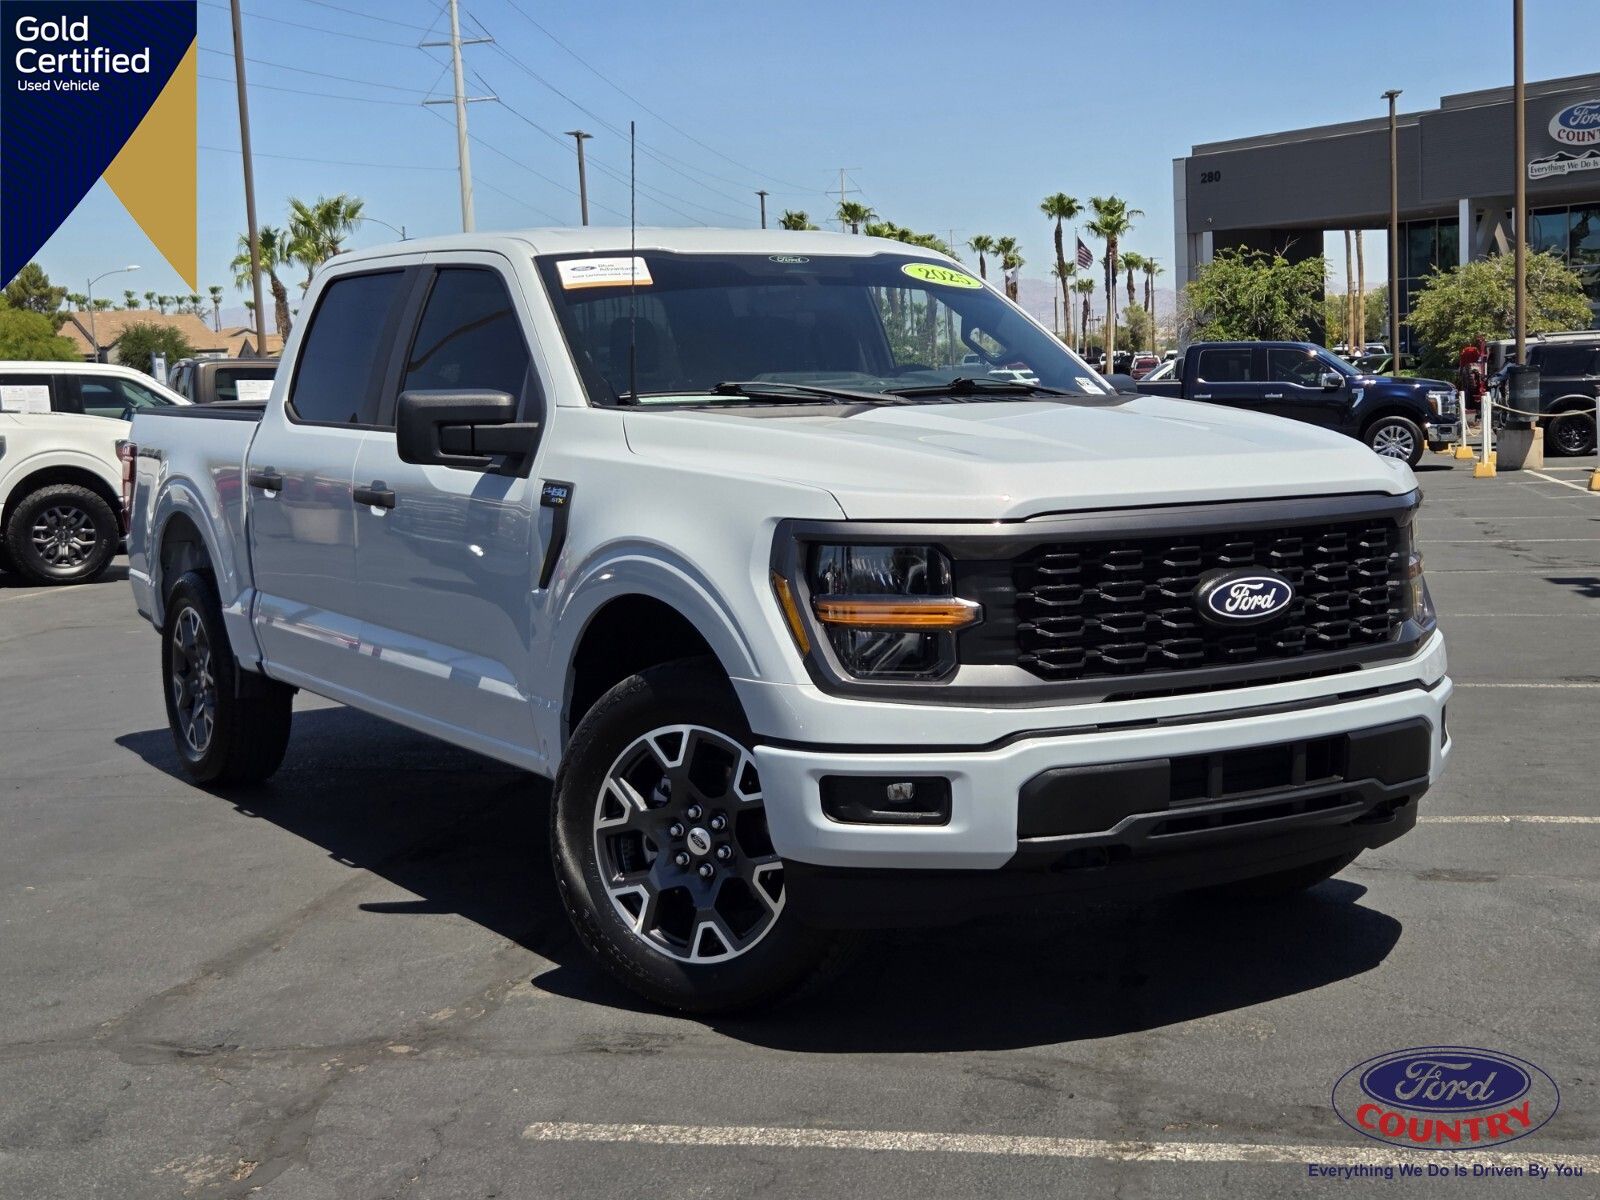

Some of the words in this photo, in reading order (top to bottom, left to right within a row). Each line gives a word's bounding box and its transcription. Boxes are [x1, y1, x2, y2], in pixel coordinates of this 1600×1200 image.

[1569, 105, 1600, 126] For
[1530, 162, 1566, 174] Everything
[1581, 160, 1591, 168] Do
[1593, 159, 1599, 167] Is
[1200, 171, 1221, 184] 280
[918, 268, 971, 285] 2025
[1225, 583, 1277, 612] Ford
